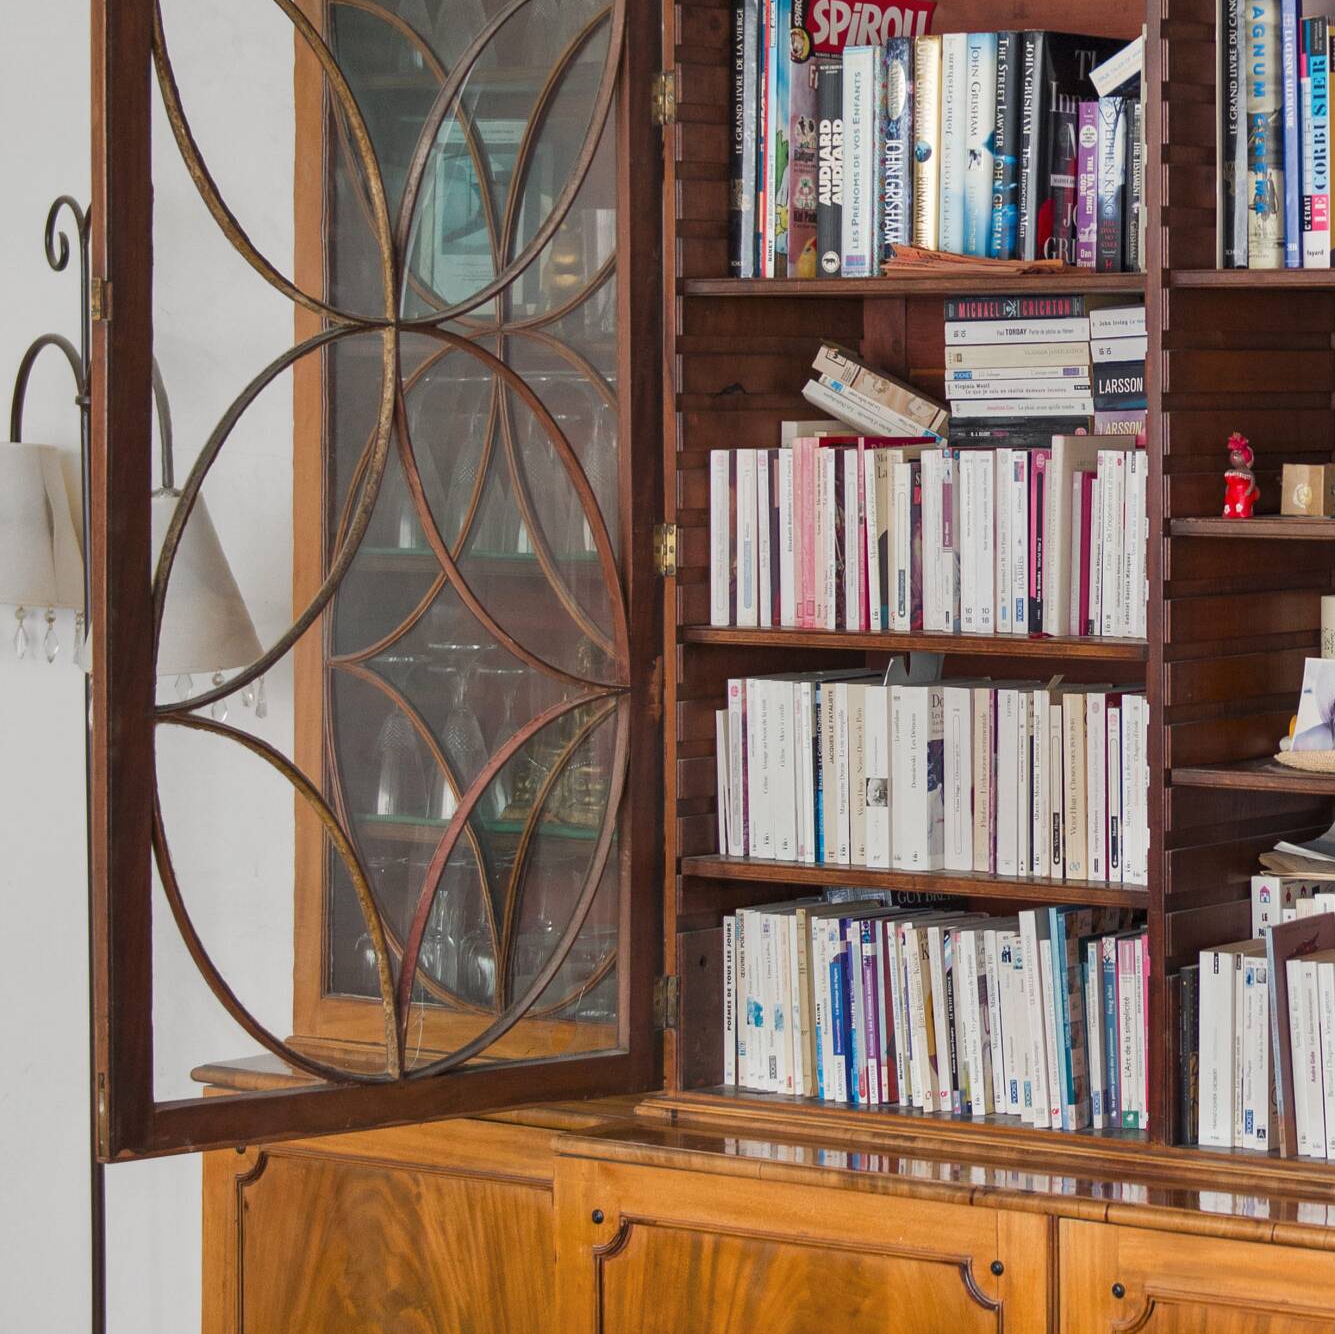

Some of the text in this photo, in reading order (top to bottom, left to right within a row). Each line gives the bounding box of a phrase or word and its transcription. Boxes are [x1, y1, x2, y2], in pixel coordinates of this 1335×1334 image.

[1229, 29, 1236, 44] DU
[736, 42, 743, 56] LA
[736, 57, 743, 71] DE
[1229, 48, 1237, 78] LIVRE
[852, 71, 861, 125] ENFANTS
[945, 53, 954, 137] John Grisham
[970, 46, 981, 137] JOHN GRISHAM
[996, 38, 1008, 148] THE STREET LAWYER
[1023, 41, 1035, 135] JOHN GRISHAM
[1229, 81, 1238, 120] GRAND
[1230, 123, 1238, 134] LE
[736, 144, 742, 154] LE
[819, 119, 832, 206] AUDIARD
[853, 154, 860, 168] DE
[1104, 111, 1116, 215] STEPHEN KING
[884, 139, 903, 244] JOHN GRISHAM
[1085, 156, 1095, 215] THE DA VINCI
[1314, 197, 1326, 222] LE
[943, 189, 952, 251] AINTED
[852, 229, 860, 249] LES
[1079, 248, 1094, 257] Dan
[958, 299, 1070, 317] MICHAEL CRICHTON
[1099, 377, 1143, 394] LARSSON
[829, 725, 833, 733] LE
[898, 891, 921, 904] GUY
[1261, 913, 1268, 922] LE
[727, 988, 732, 998] DE
[1123, 996, 1132, 1033] simplicité
[1124, 1045, 1131, 1055] de
[1123, 1057, 1132, 1078] L'Art
